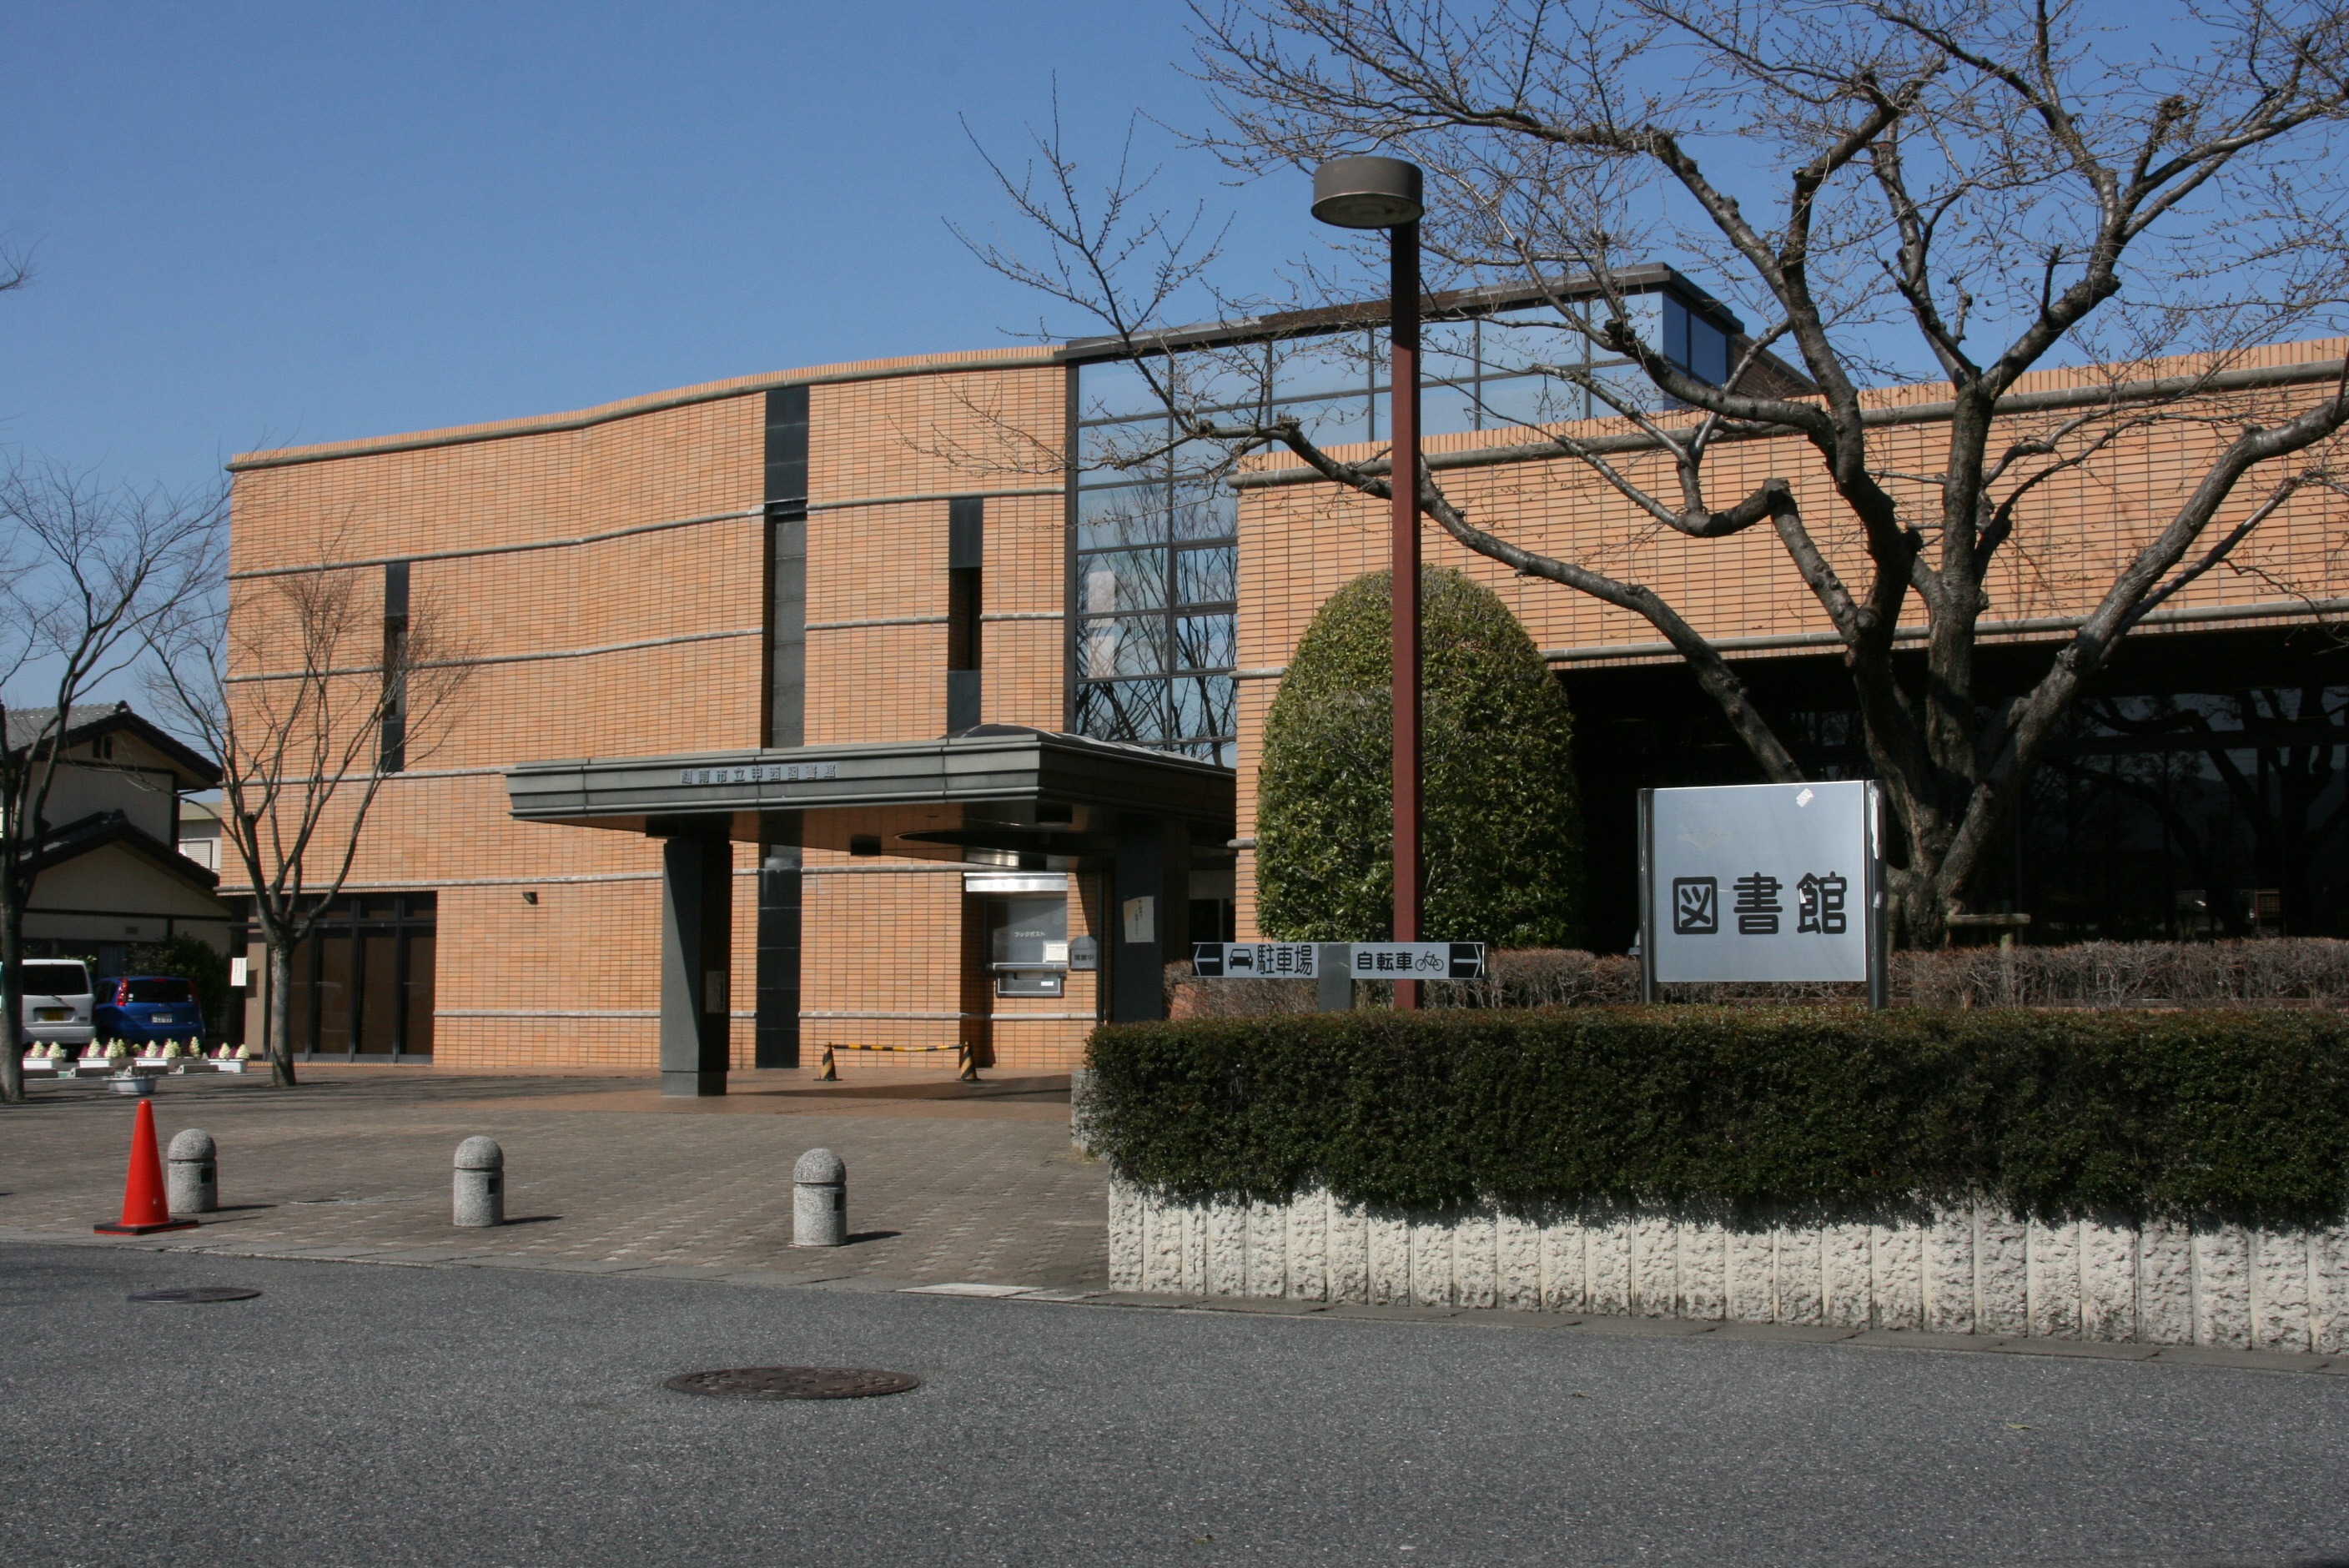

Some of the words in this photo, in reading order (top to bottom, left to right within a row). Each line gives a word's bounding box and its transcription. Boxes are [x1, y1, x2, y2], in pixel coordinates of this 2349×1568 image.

[1672, 871, 1847, 935] 図書館
[1256, 944, 1313, 975] 駐車場
[1356, 951, 1413, 972] 自転車
